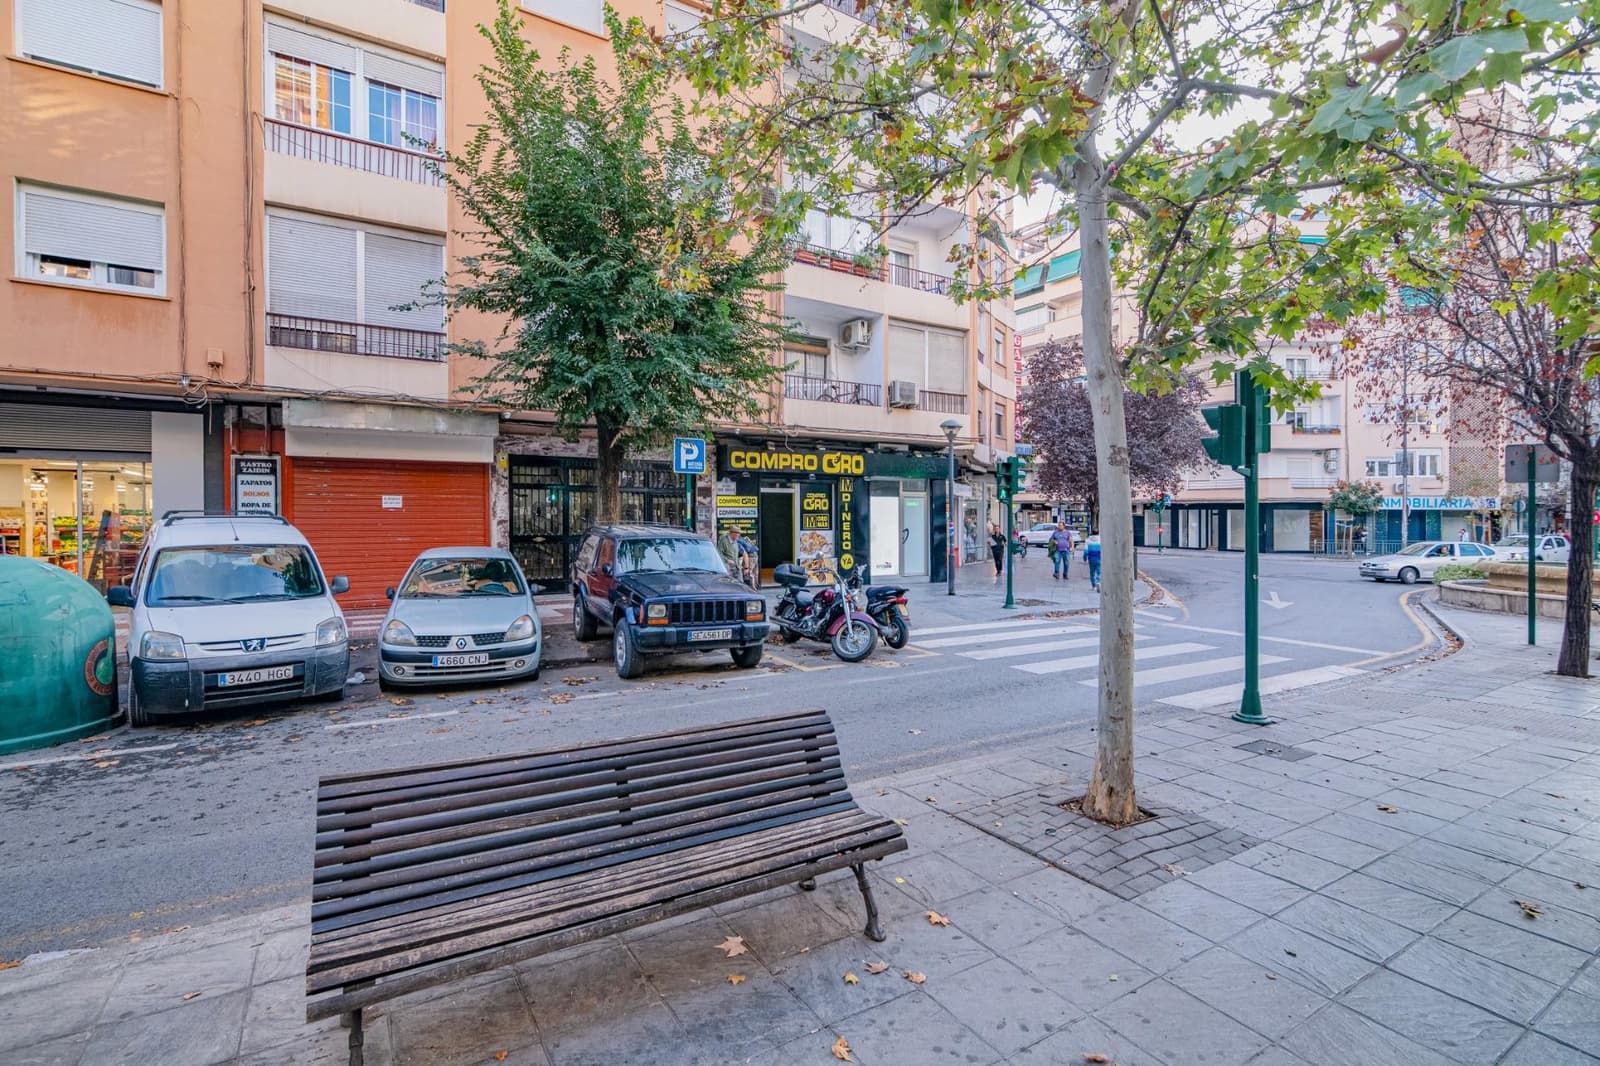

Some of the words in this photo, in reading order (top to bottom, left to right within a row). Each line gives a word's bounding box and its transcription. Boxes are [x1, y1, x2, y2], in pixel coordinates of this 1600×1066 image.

[681, 442, 698, 468] P
[731, 451, 818, 471] COMPRO
[1379, 498, 1472, 508] NMBILIARIA
[842, 493, 851, 550] DINERO
[439, 656, 465, 665] 4660
[468, 655, 487, 664] CNJ
[228, 671, 262, 684] 3440
